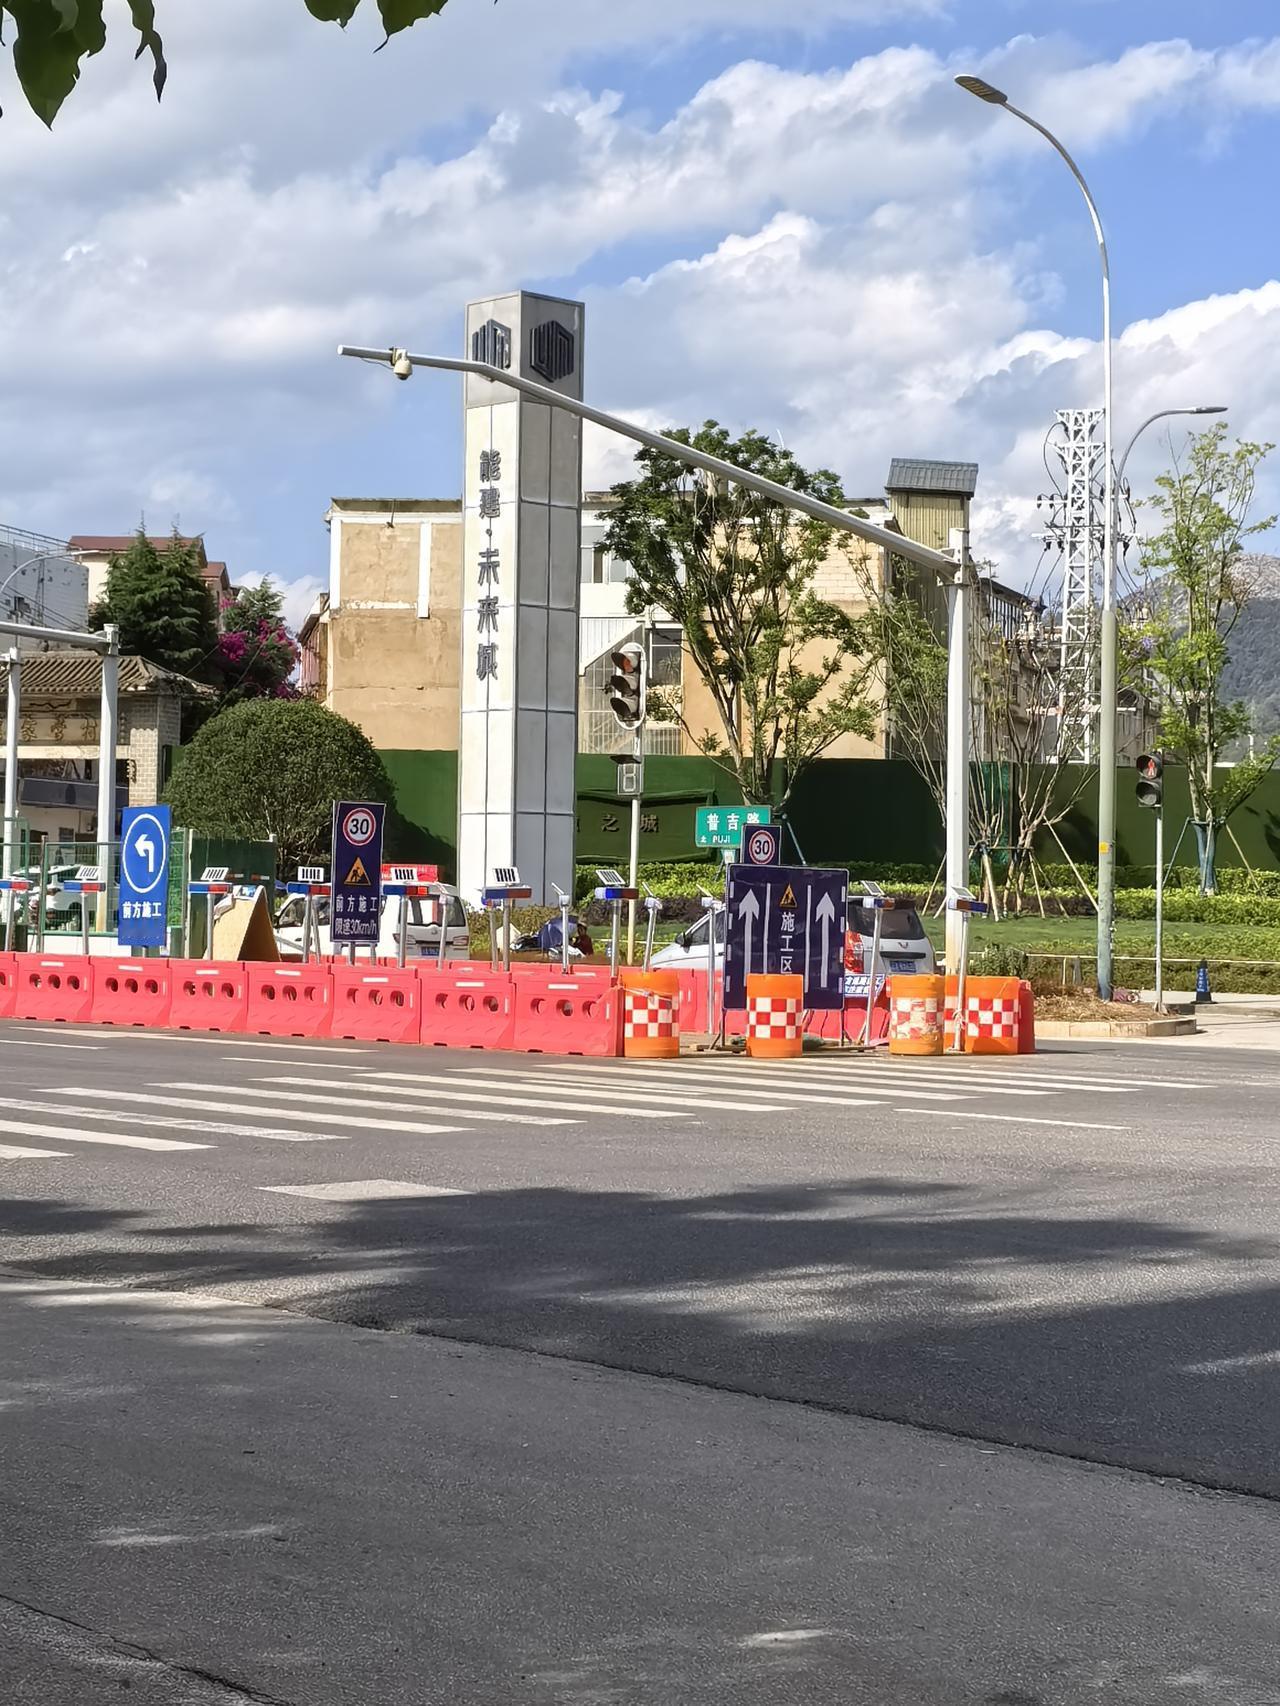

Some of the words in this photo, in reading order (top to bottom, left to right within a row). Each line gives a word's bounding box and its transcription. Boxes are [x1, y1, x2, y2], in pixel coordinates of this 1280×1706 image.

[349, 818, 370, 835] 30
[577, 814, 660, 833] 之城
[706, 812, 760, 831] 普吉路
[712, 835, 731, 844] PUJI
[754, 840, 770, 855] 30
[122, 901, 162, 919] 前方施工
[335, 894, 378, 913] 前方施工
[780, 911, 796, 974] 施工区
